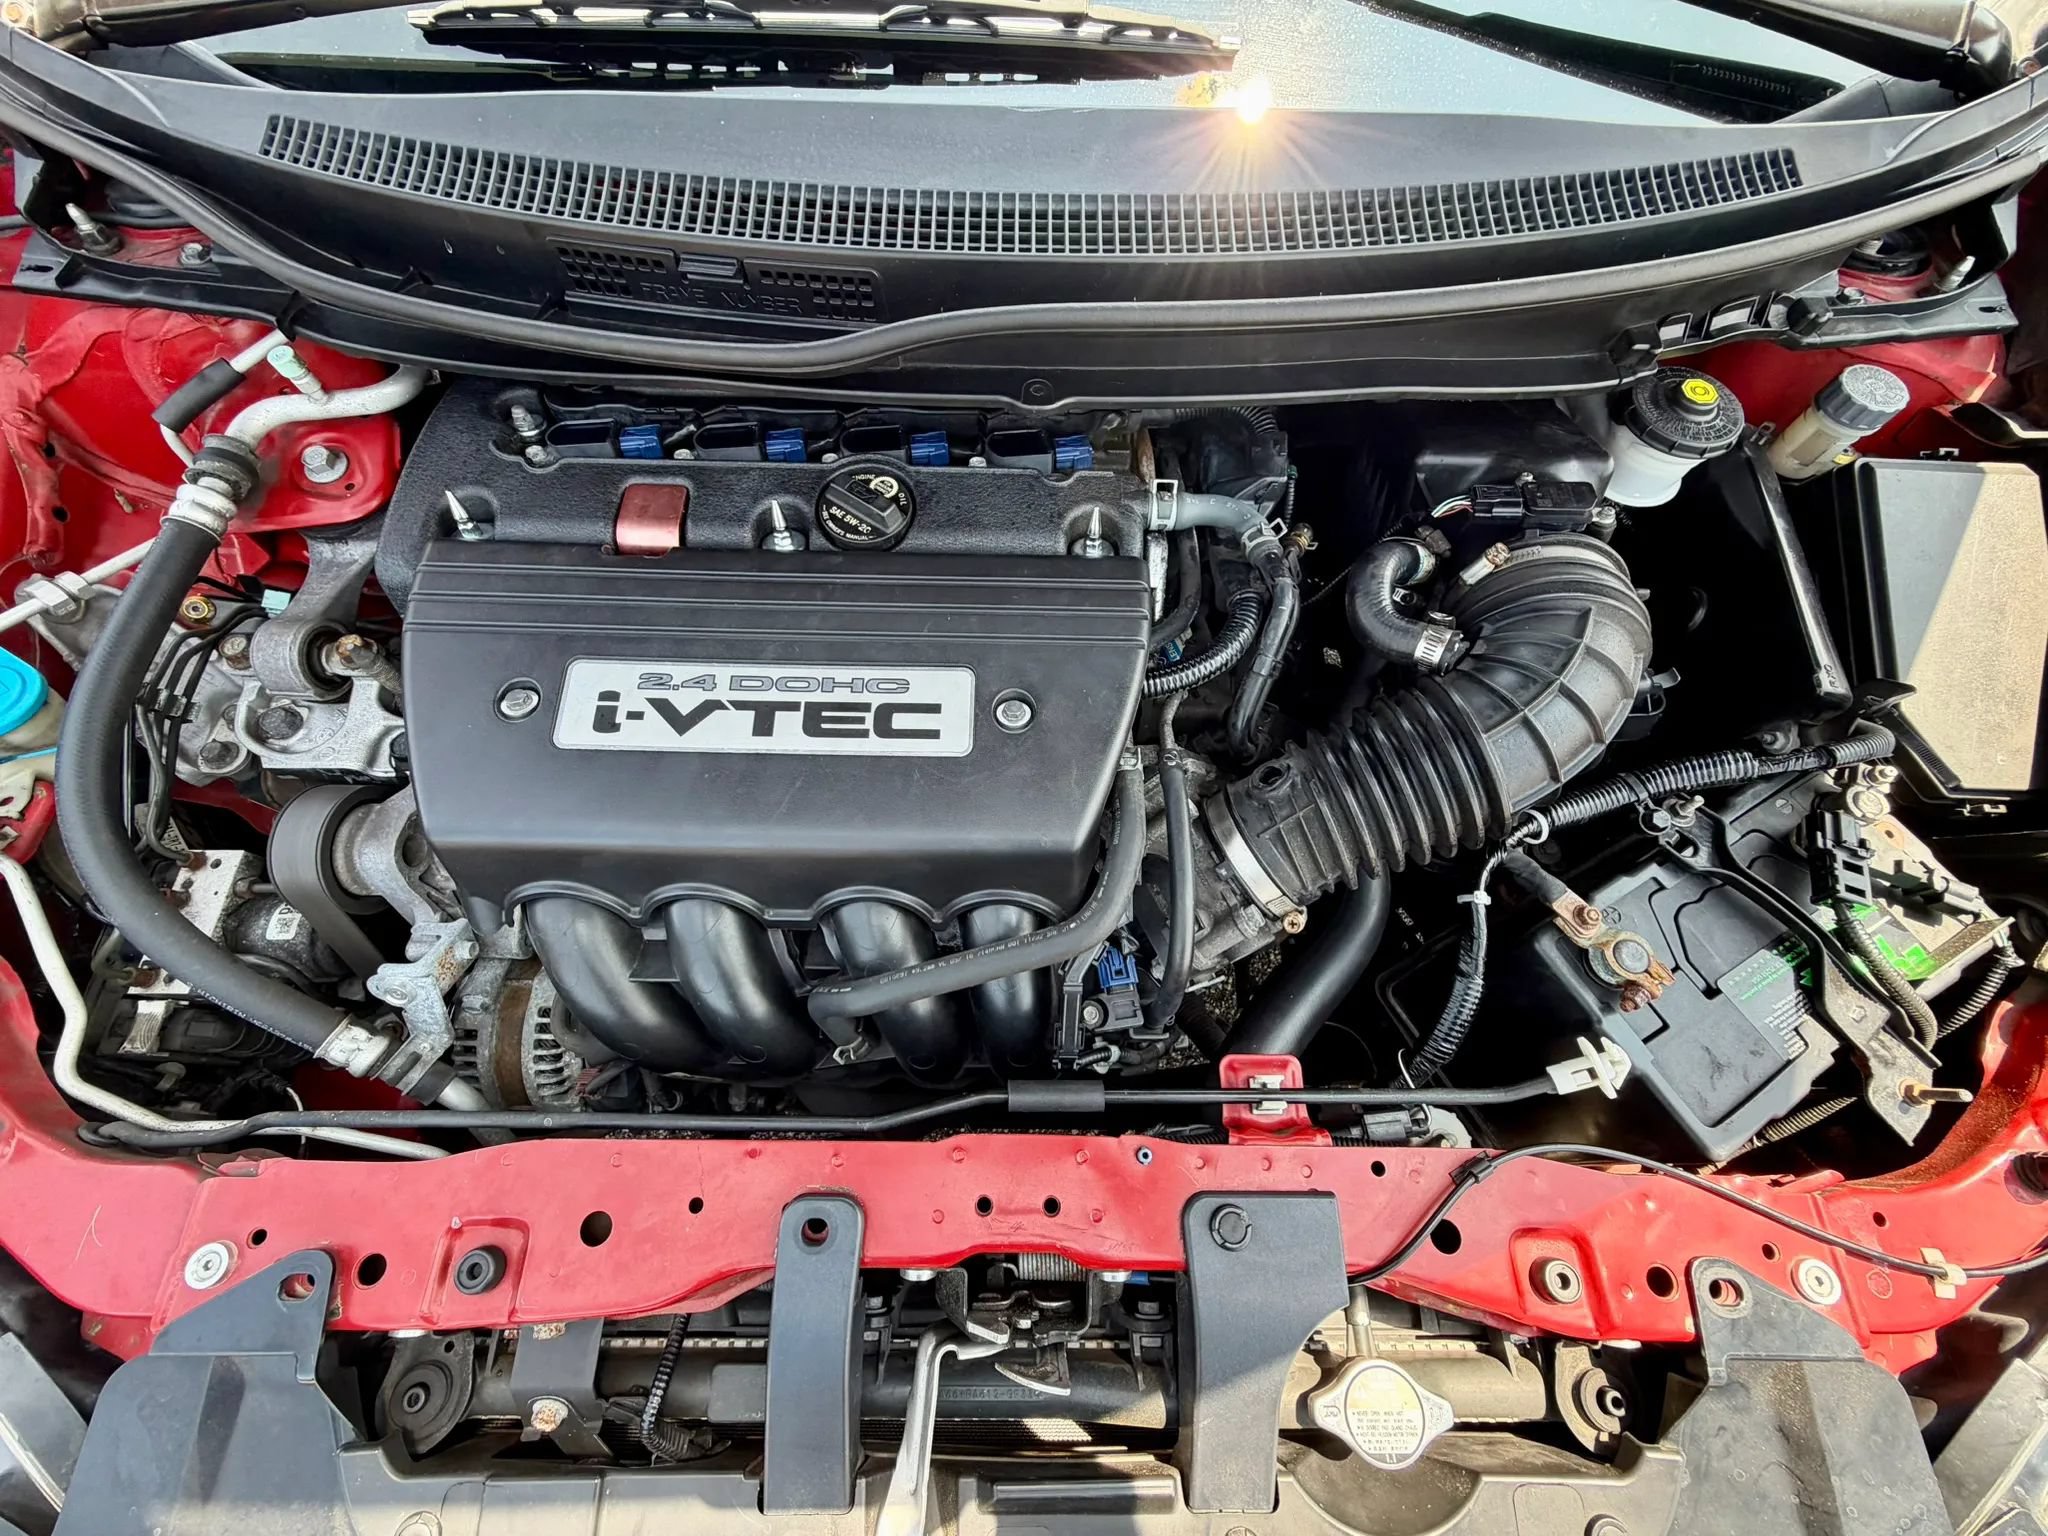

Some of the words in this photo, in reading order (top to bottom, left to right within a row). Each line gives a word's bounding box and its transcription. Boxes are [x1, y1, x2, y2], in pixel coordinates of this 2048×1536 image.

[640, 281, 708, 304] FRAME
[720, 291, 802, 313] NUMBER
[898, 492, 908, 506] OIL
[829, 506, 846, 519] SAE
[843, 514, 872, 534] 5W-20
[637, 672, 717, 692] 2.4
[729, 674, 910, 694] DOHC
[592, 689, 943, 740] i-VTEC
